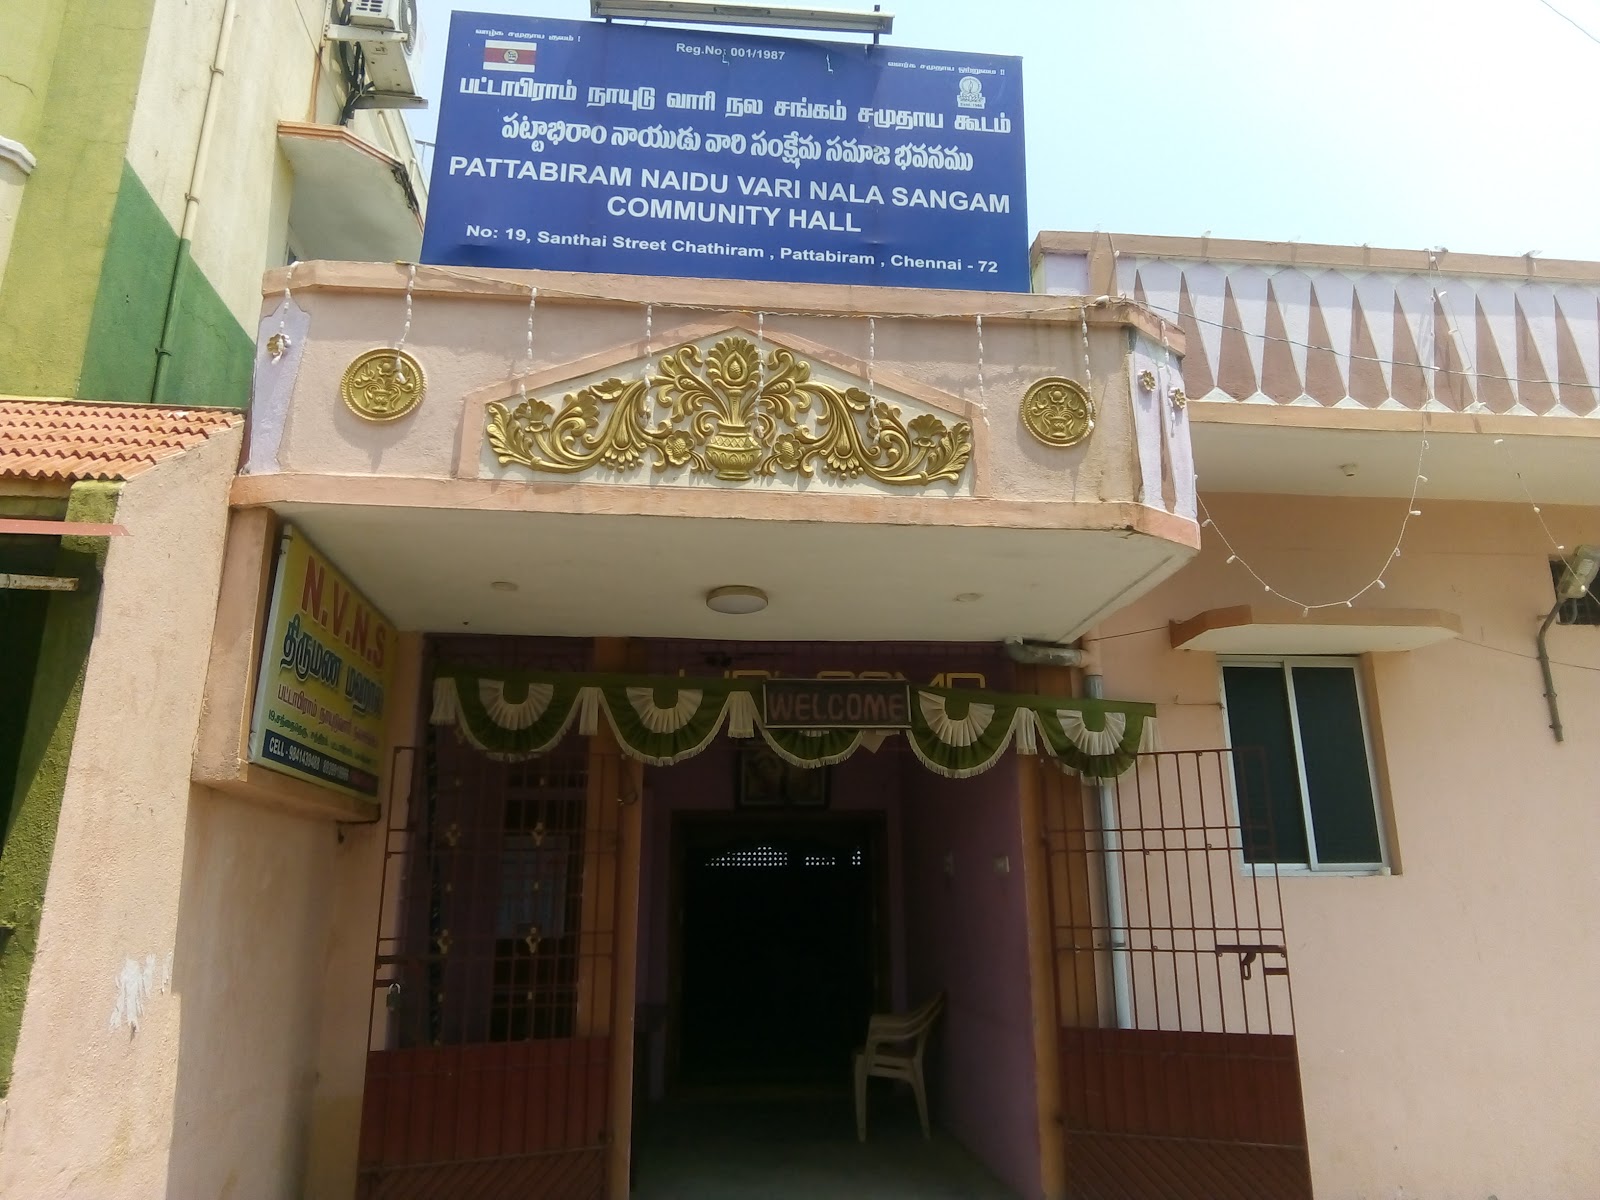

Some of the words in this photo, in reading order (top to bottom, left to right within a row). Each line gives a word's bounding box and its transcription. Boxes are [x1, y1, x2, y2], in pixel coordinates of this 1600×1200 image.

[730, 47, 785, 60] 001/1987
[459, 77, 578, 102] பட்டாபிராம்
[586, 86, 656, 111] நாயுடு
[666, 90, 716, 111] வாரி
[725, 96, 763, 118] நல
[774, 97, 847, 121] சங்கம்
[858, 109, 943, 131] சமுதாய
[954, 112, 1012, 134] கூடம்
[501, 112, 608, 152] పట్టాభిరాం
[611, 123, 700, 152] నాయుడు
[705, 132, 746, 154] వారి
[750, 130, 822, 169] సంక్షేమ
[825, 136, 891, 165] సమాజ
[895, 142, 974, 172] భవనము
[449, 156, 632, 187] PATTABIRAM
[641, 168, 728, 194] NAIDU
[737, 175, 801, 198] VARI
[810, 180, 885, 205] NALA
[892, 187, 1011, 214] SANGAM
[607, 196, 782, 227] COMMUNITY
[788, 208, 862, 232] HALL
[466, 224, 499, 239] No:
[505, 227, 531, 243] 19,
[537, 230, 607, 248] Santhai
[612, 236, 667, 251] Street
[671, 240, 764, 258] Chathiram
[780, 247, 875, 265] Pattabiram
[891, 254, 962, 271] Chennai
[978, 260, 998, 273] 72
[301, 556, 386, 669] N.V.N.S
[280, 613, 342, 688] திருமண
[769, 692, 906, 722] WELCOME
[269, 736, 285, 757] CELL
